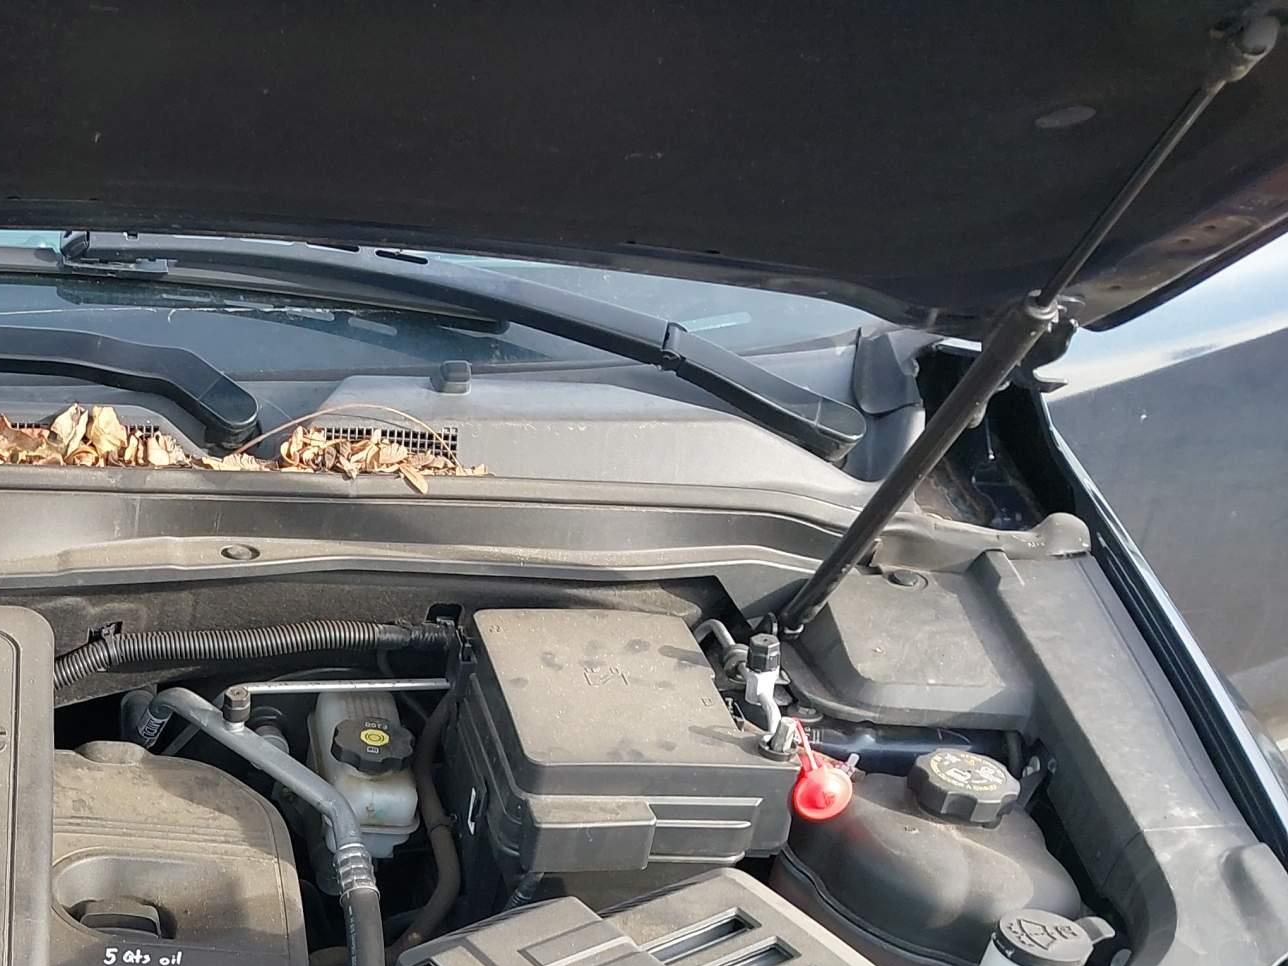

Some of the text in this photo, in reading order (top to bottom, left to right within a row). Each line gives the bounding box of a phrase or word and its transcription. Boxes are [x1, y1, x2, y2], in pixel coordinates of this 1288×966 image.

[365, 721, 382, 729] DOT
[103, 947, 118, 965] 5
[159, 951, 183, 966] oil
